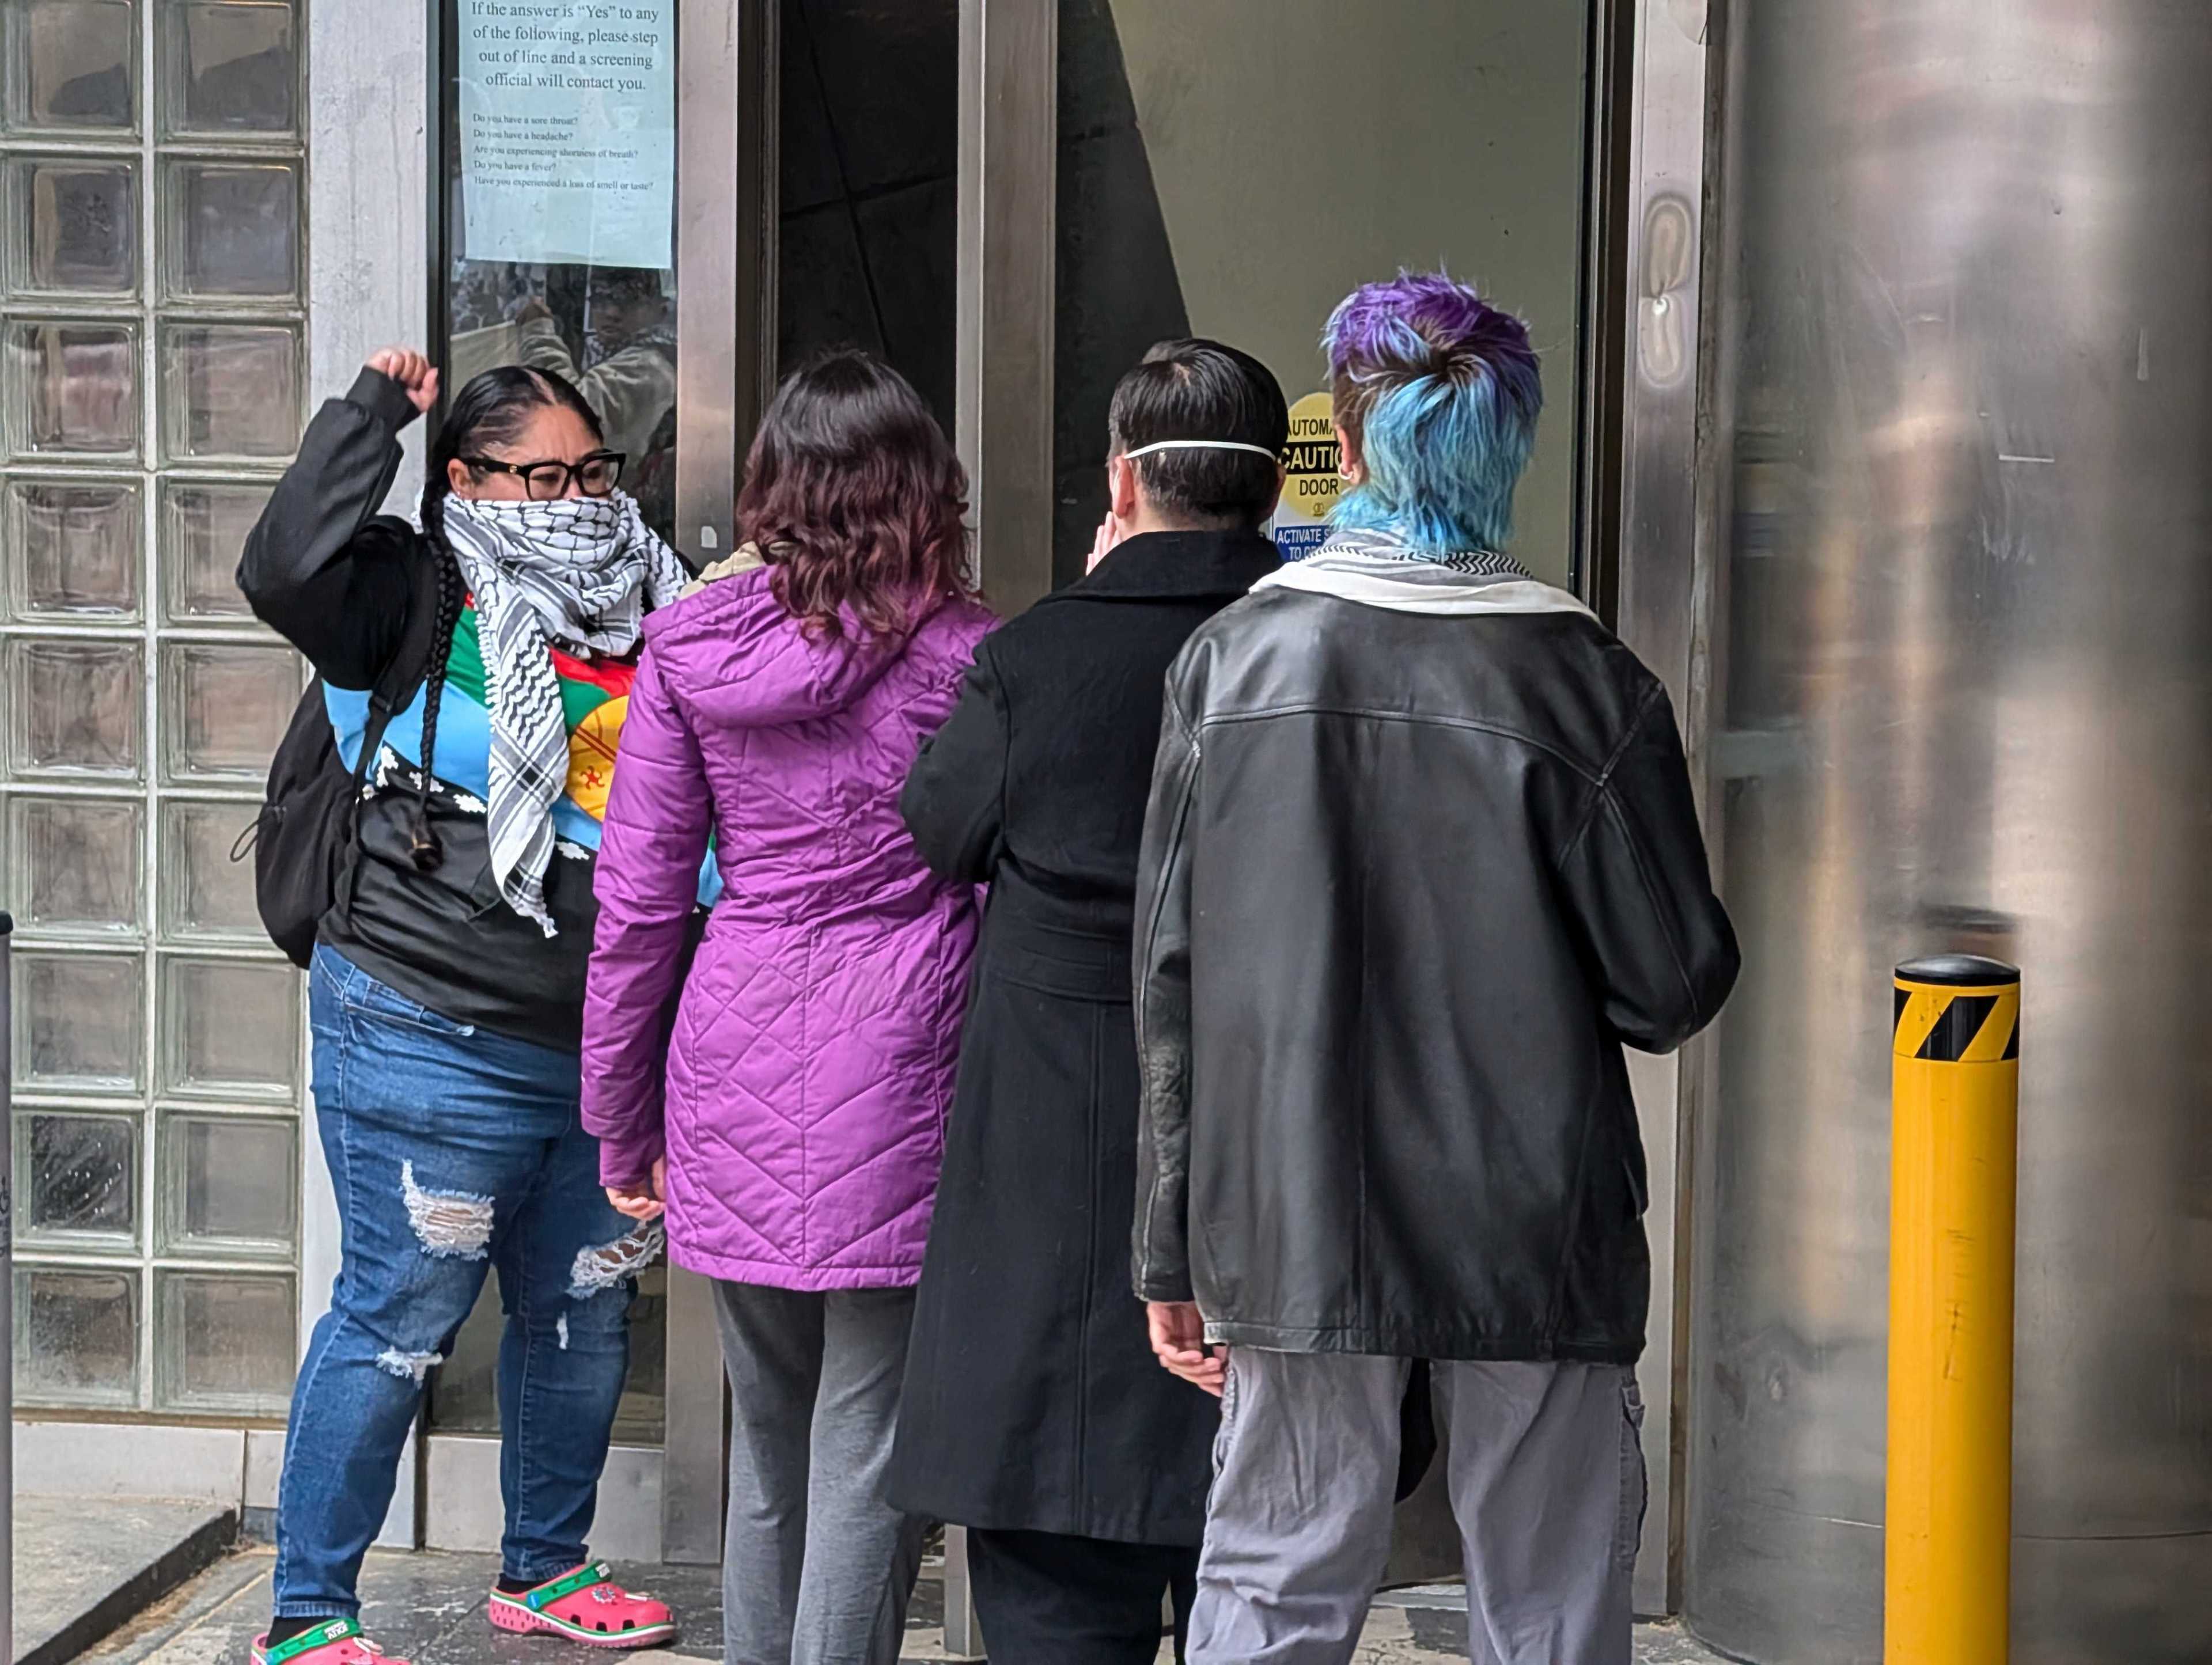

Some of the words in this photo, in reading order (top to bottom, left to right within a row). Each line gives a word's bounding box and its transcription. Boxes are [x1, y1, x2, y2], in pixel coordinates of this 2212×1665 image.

[472, 2, 483, 15] If
[487, 2, 506, 16] the
[510, 6, 559, 17] answer
[563, 5, 574, 17] is
[620, 7, 632, 19] to
[636, 9, 658, 23] any
[473, 25, 488, 39] of
[491, 26, 510, 39] the
[516, 26, 584, 44] following,
[589, 29, 628, 45] please
[632, 32, 658, 46] step
[479, 51, 499, 62] out
[504, 50, 520, 63] of
[522, 50, 547, 63] line
[551, 51, 575, 65] and
[579, 55, 586, 65] a
[590, 53, 653, 70] screening
[486, 72, 532, 86] official
[537, 74, 564, 88] will
[567, 77, 614, 89] contact
[618, 79, 646, 92] you.
[473, 114, 485, 122] Do
[488, 116, 502, 124] you
[504, 115, 521, 124] have
[474, 129, 485, 138] Do
[488, 132, 502, 141] you
[504, 130, 522, 139] have
[531, 132, 573, 141] headache?
[474, 145, 488, 153] Are
[490, 147, 505, 155] you
[506, 148, 557, 158] experiencing
[474, 160, 486, 169] Do
[488, 163, 502, 171] you
[505, 161, 522, 170] have
[475, 176, 494, 185] Have
[513, 177, 560, 188] experienced
[597, 181, 618, 189] smell
[1300, 478, 1339, 495] DOOR
[1277, 528, 1321, 544] ACTIVATE
[1289, 546, 1302, 560] TO
